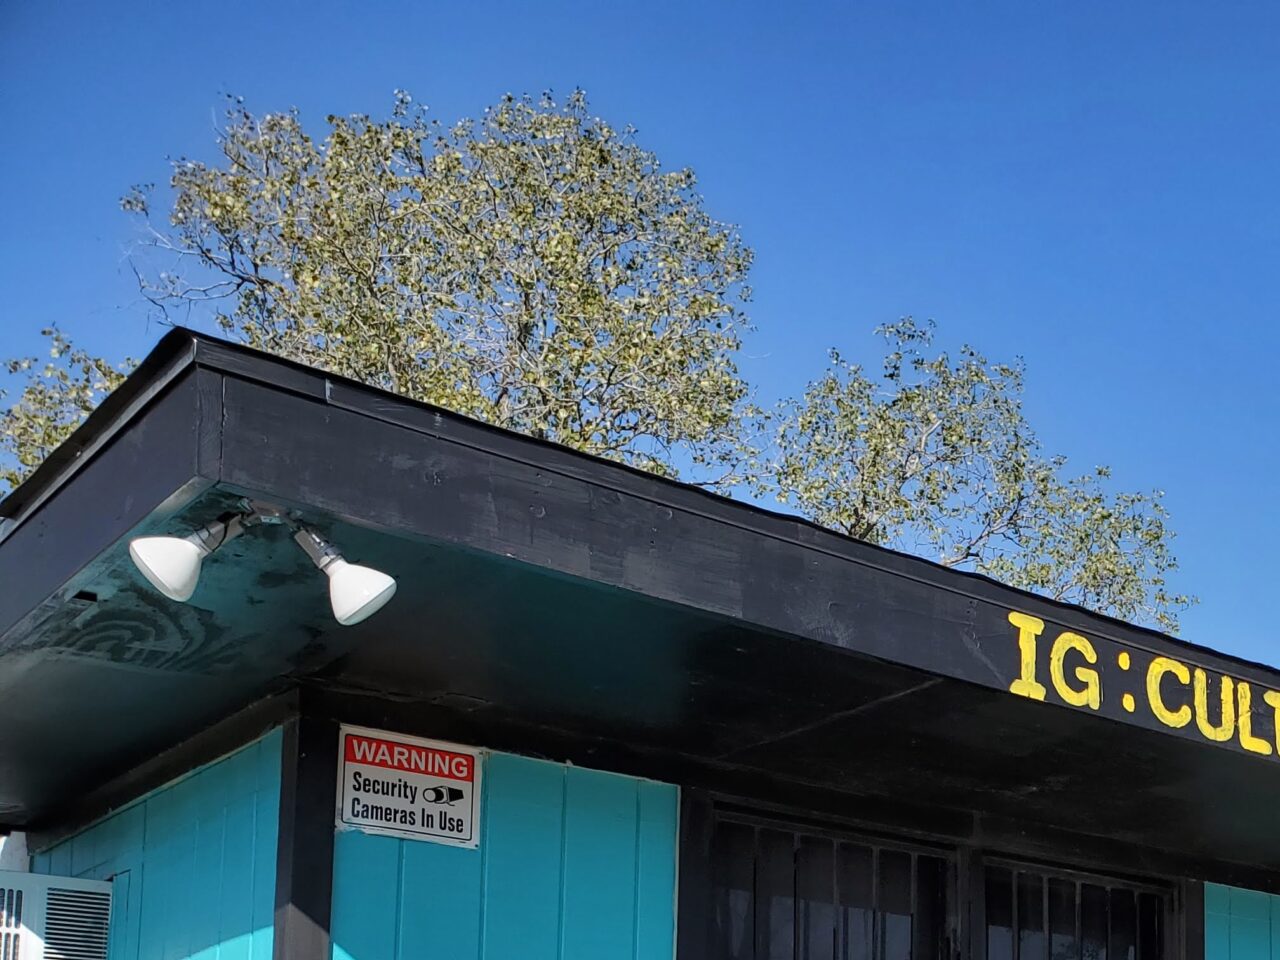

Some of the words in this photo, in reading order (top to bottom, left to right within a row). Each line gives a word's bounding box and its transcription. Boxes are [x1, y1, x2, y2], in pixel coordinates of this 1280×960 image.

[352, 739, 468, 778] WARNING
[352, 771, 418, 804] Security
[351, 797, 416, 826] Cameras
[421, 808, 434, 829] In
[439, 811, 464, 833] Use
